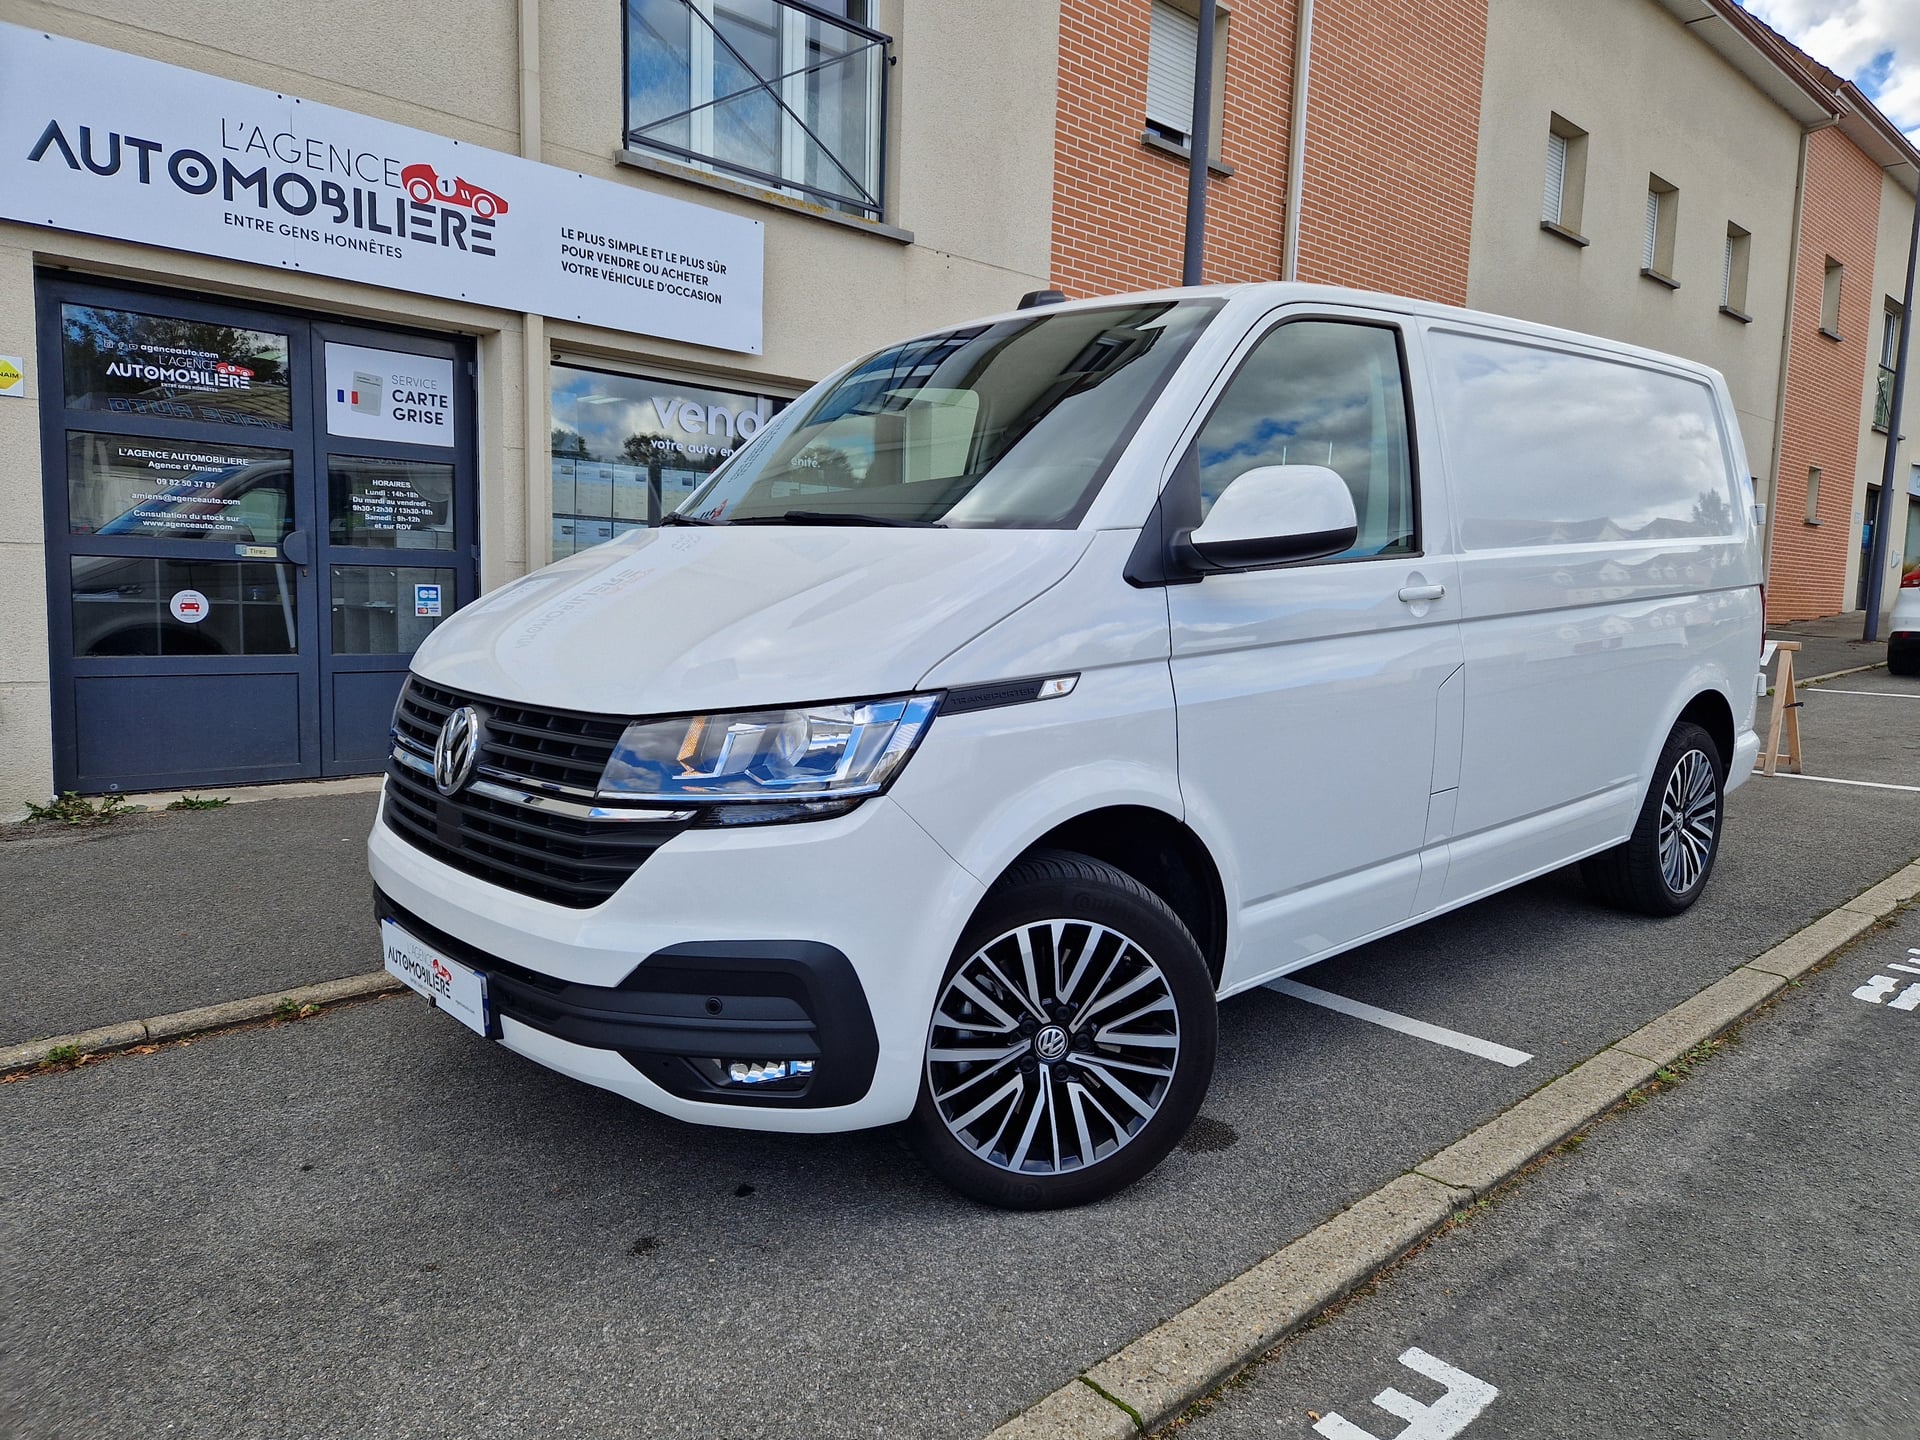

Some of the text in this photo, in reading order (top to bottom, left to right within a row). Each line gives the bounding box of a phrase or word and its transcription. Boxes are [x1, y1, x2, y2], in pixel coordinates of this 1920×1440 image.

[221, 117, 401, 189] L'AGENCE
[223, 212, 403, 260] ENTRE GENS HONNÊTES
[561, 227, 728, 275] LE PLUS SIMPLE ET LE PLUS SÛR
[561, 243, 709, 286] POUR VENDRE OU ACHETER
[561, 260, 723, 305] VOTRE VÉHICULE D'OCCASION
[140, 343, 220, 359] agenceauto.com
[158, 355, 217, 371] L'AGENCE
[391, 374, 437, 390] SERVICE
[391, 389, 448, 408] CARTE
[392, 407, 444, 425] GRISE
[651, 394, 766, 440] vend
[650, 439, 684, 452] votre
[687, 443, 717, 456] auto
[118, 447, 249, 466] L'AGENCE AUTOMOBILIERE
[148, 460, 223, 473] Agence d'Amiens
[156, 477, 216, 489] 09 82 50 37 97
[373, 480, 411, 488] HORAIRES
[131, 491, 241, 506] amiens@agenceauto.com
[133, 509, 188, 520] Consultation
[189, 512, 201, 521] du
[202, 513, 224, 522] stock
[143, 520, 233, 531] www.agenceauto.com
